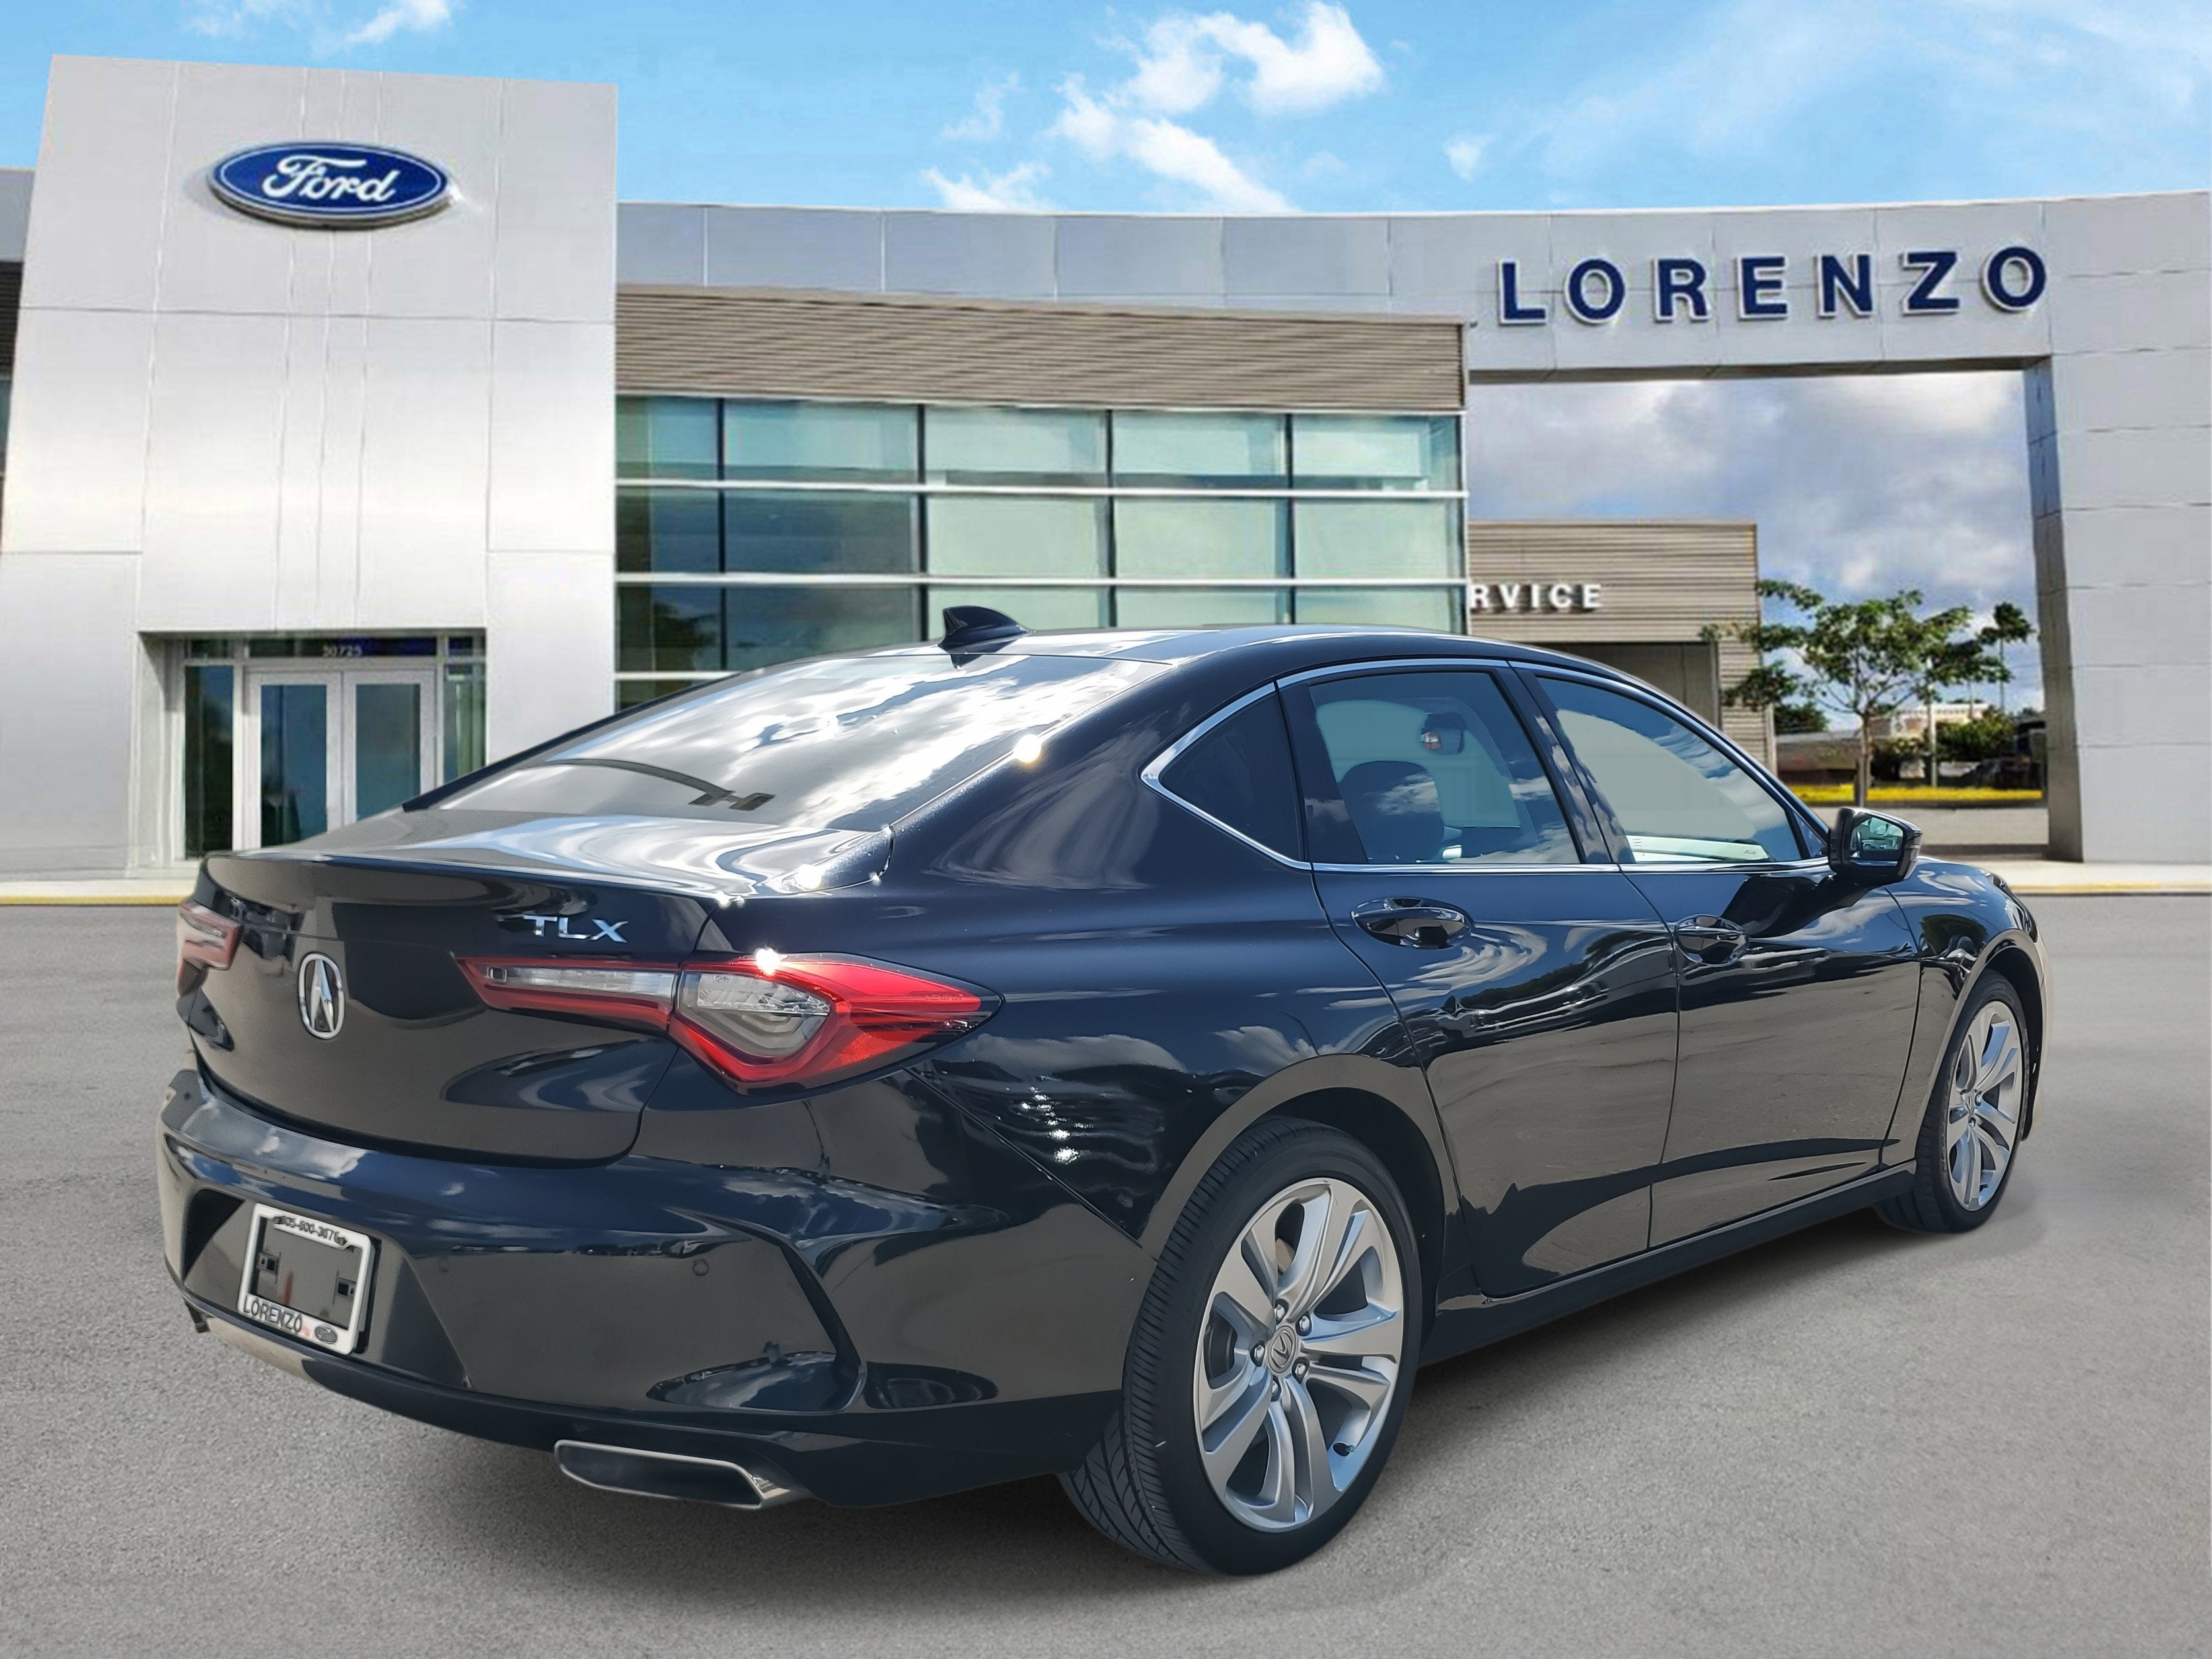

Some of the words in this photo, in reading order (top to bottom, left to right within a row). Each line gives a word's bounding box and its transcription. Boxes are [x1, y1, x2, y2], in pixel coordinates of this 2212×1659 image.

[262, 155, 400, 202] Ford
[1498, 245, 2047, 324] LORENZO
[1470, 583, 1602, 608] RVICE
[523, 914, 629, 943] TLX
[243, 1296, 303, 1333] LORENZO
